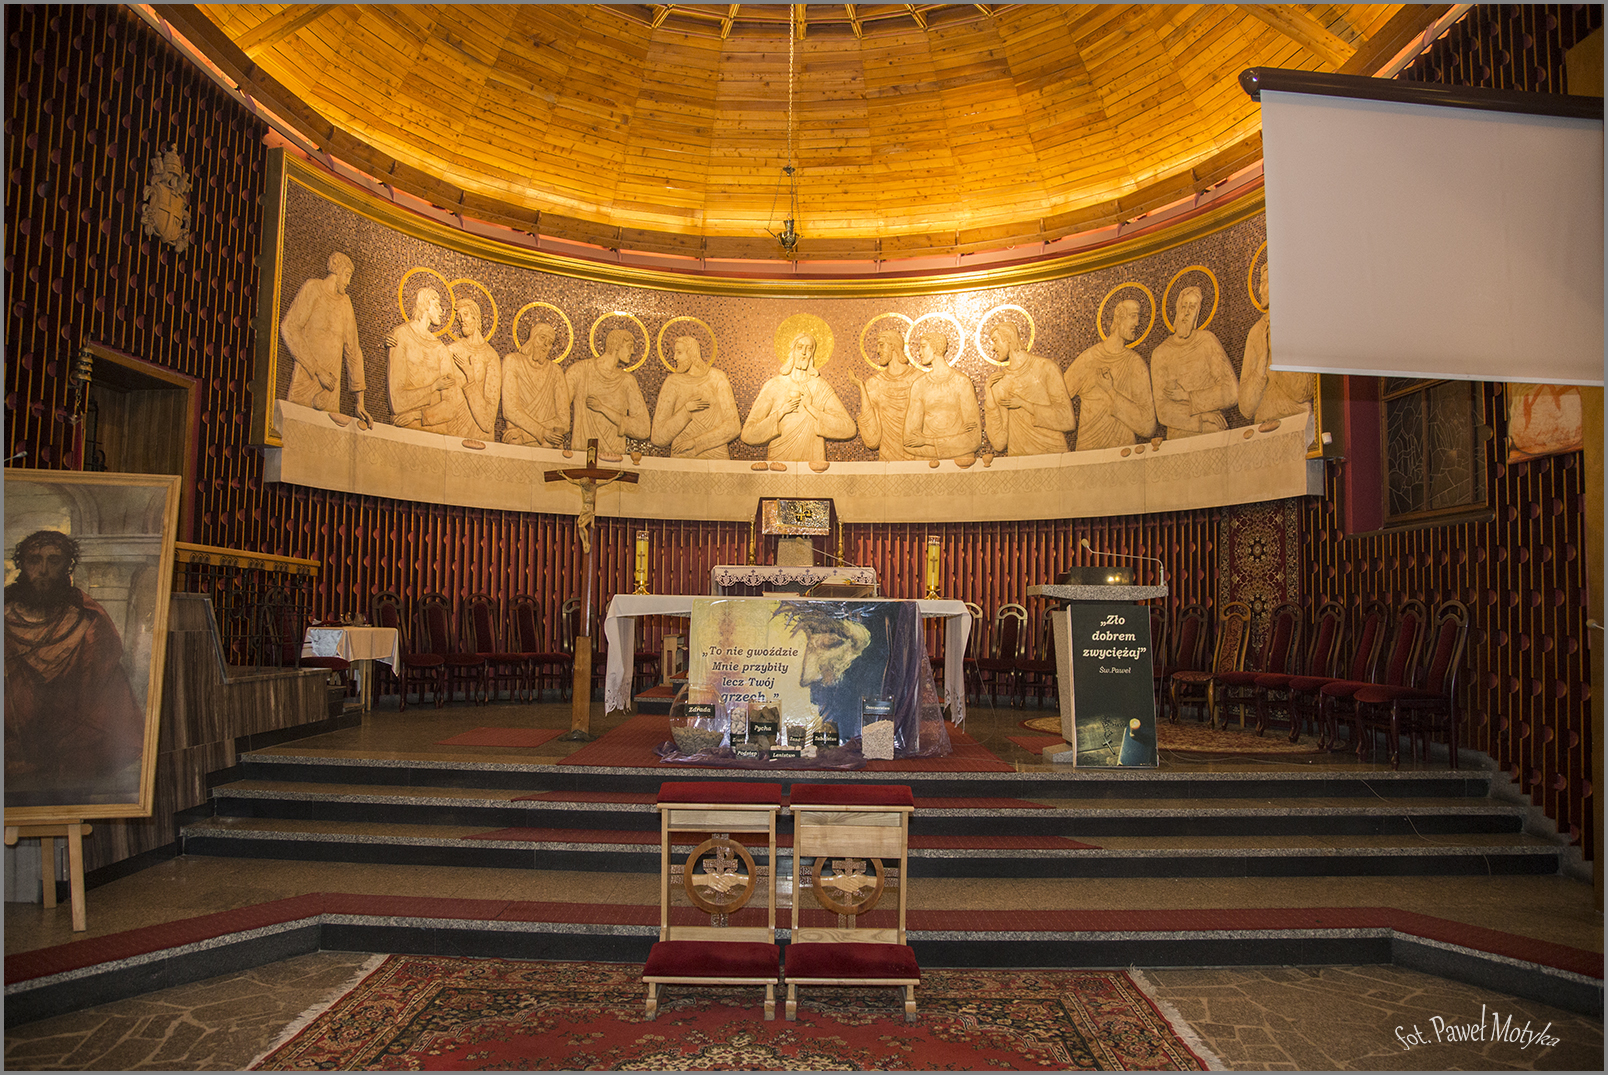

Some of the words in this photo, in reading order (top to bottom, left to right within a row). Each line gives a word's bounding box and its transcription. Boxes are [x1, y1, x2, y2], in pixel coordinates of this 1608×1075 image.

[1100, 615, 1126, 627] „Zło
[1092, 630, 1136, 642] dobrem
[726, 646, 744, 656] nie
[746, 646, 799, 659] gwoździe
[712, 661, 739, 671] Mnie
[741, 662, 789, 674] przybiły
[722, 677, 744, 687] lecz
[748, 677, 776, 690] Twój
